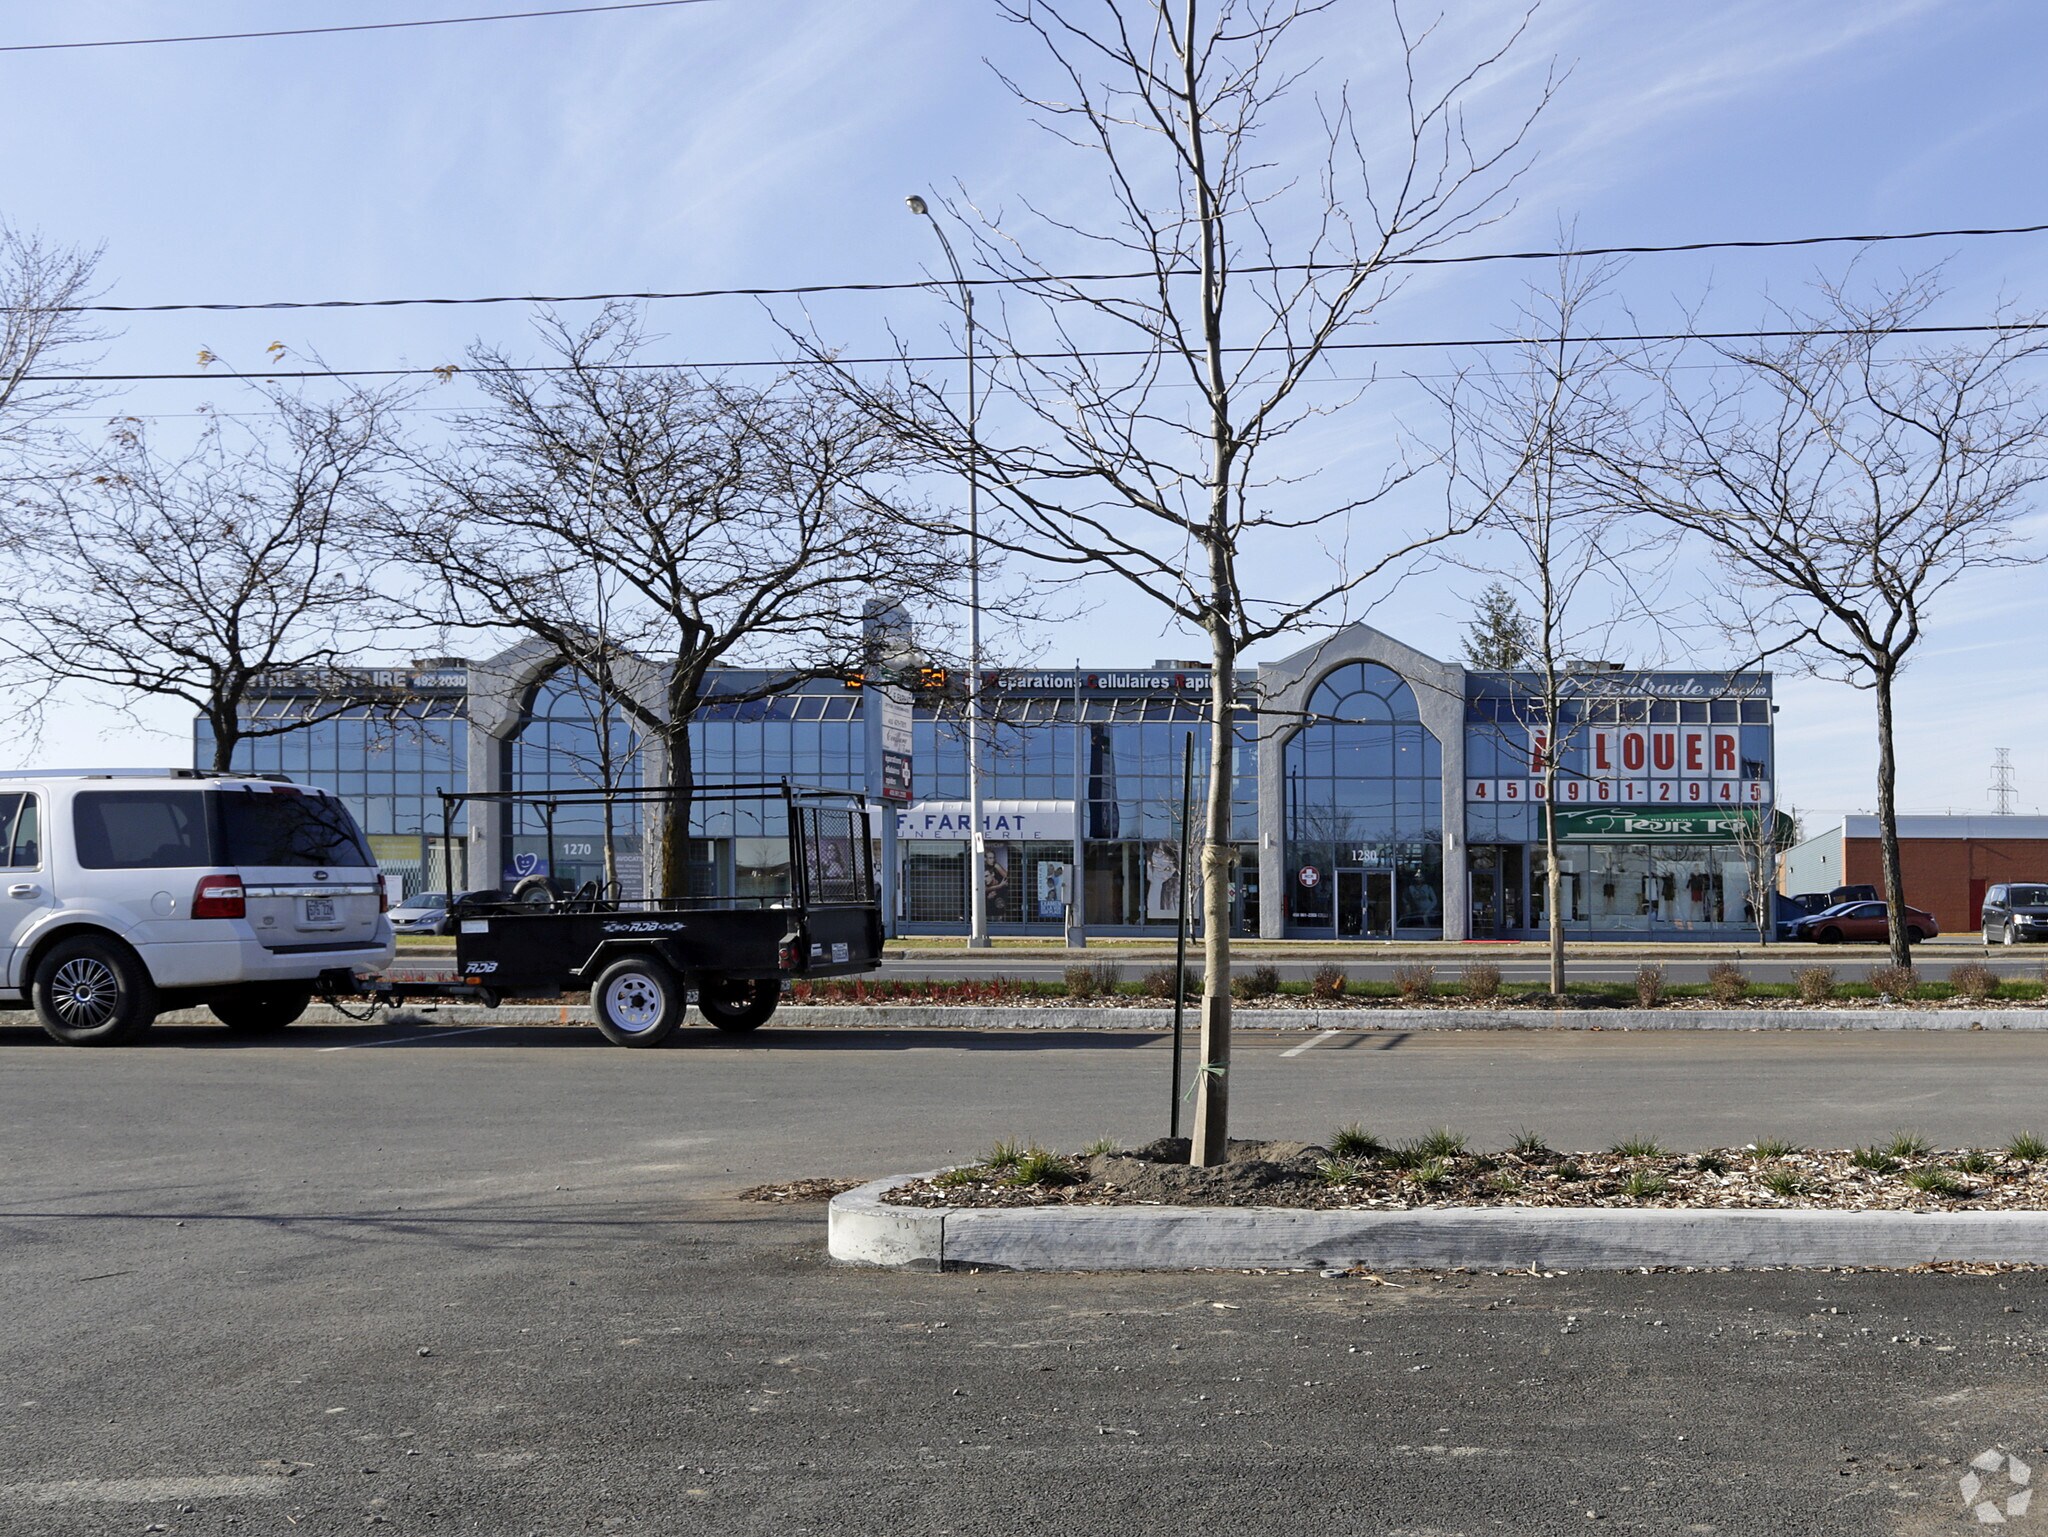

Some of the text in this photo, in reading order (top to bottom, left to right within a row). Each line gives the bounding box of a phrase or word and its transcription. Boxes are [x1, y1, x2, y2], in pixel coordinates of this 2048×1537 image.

[414, 675, 467, 687] 492-2030
[1087, 673, 1169, 689] Cellulaires
[1174, 673, 1238, 692] Rapis
[1596, 733, 1736, 771] LOUER
[925, 815, 1025, 831] FARHAT
[893, 830, 1041, 840] UNETERIE
[563, 843, 591, 855] 1270
[1351, 849, 1377, 861] 1280
[465, 961, 498, 973] RDB
